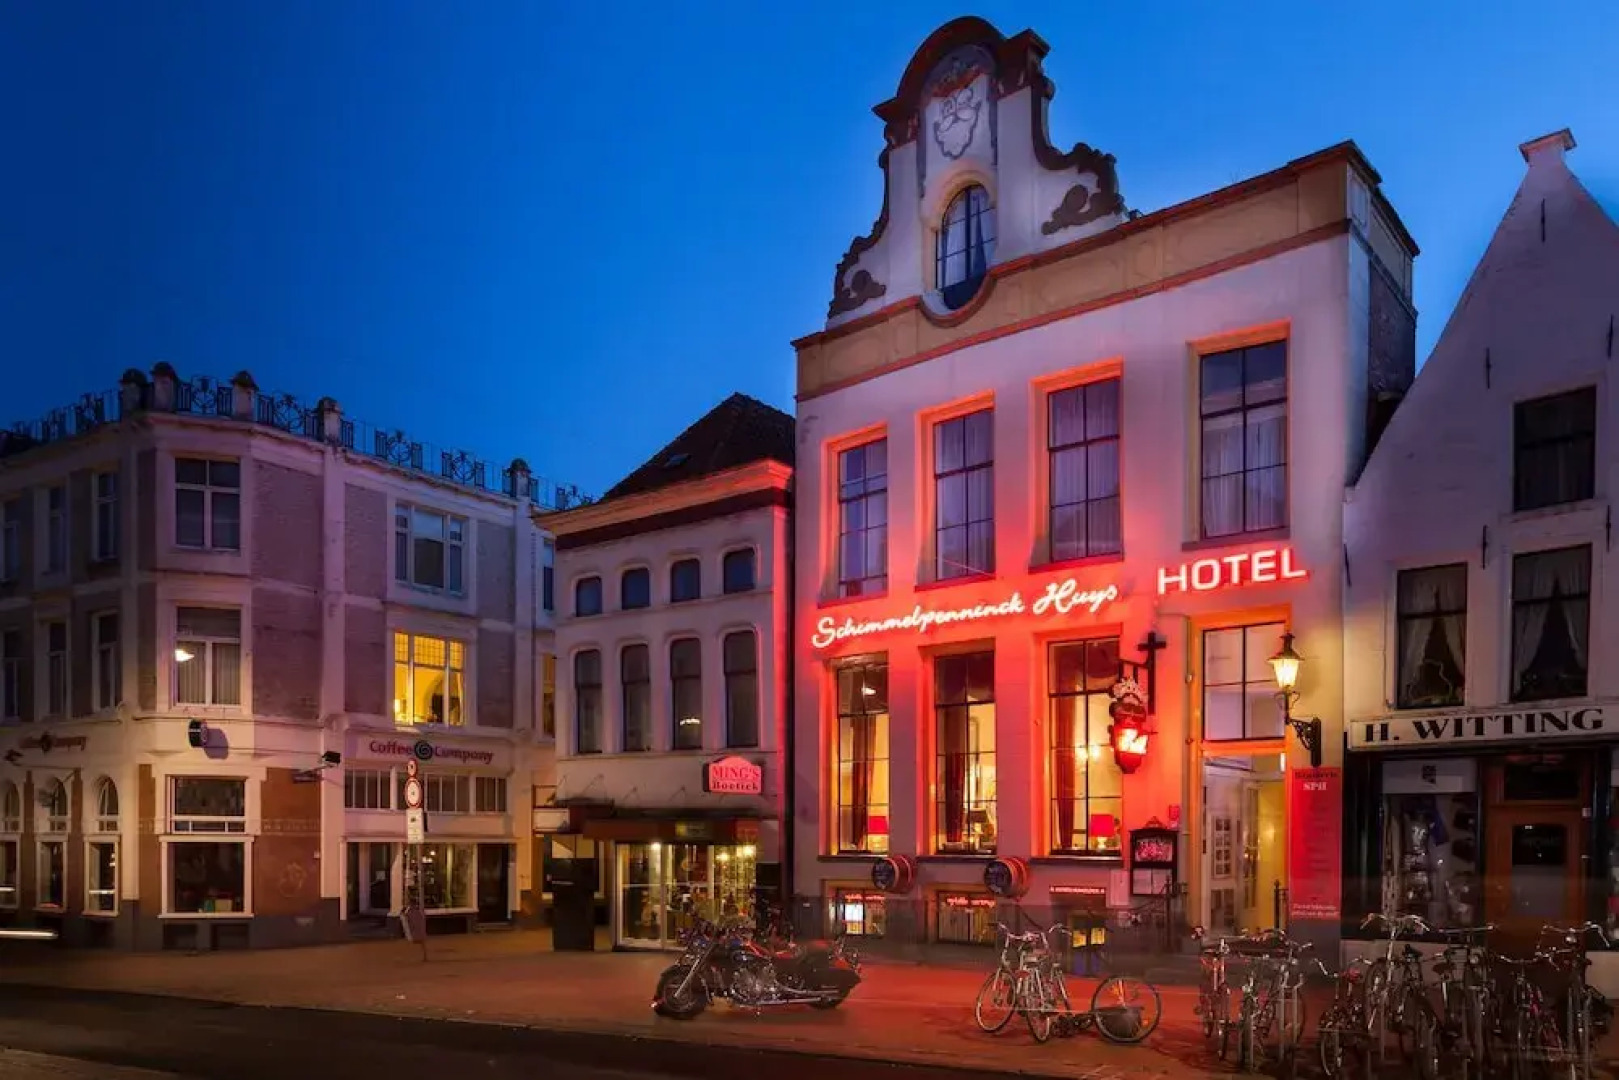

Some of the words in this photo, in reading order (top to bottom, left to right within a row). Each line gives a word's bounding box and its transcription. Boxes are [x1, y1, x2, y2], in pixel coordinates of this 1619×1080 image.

[1157, 549, 1307, 595] HOTEL
[811, 591, 1025, 649] Schimmelpenninck
[1033, 579, 1118, 615] Huys
[1364, 722, 1400, 742] H.
[1412, 708, 1604, 740] WITTING
[369, 740, 414, 755] Coffee
[434, 746, 494, 764] Company
[711, 765, 760, 779] MING'S
